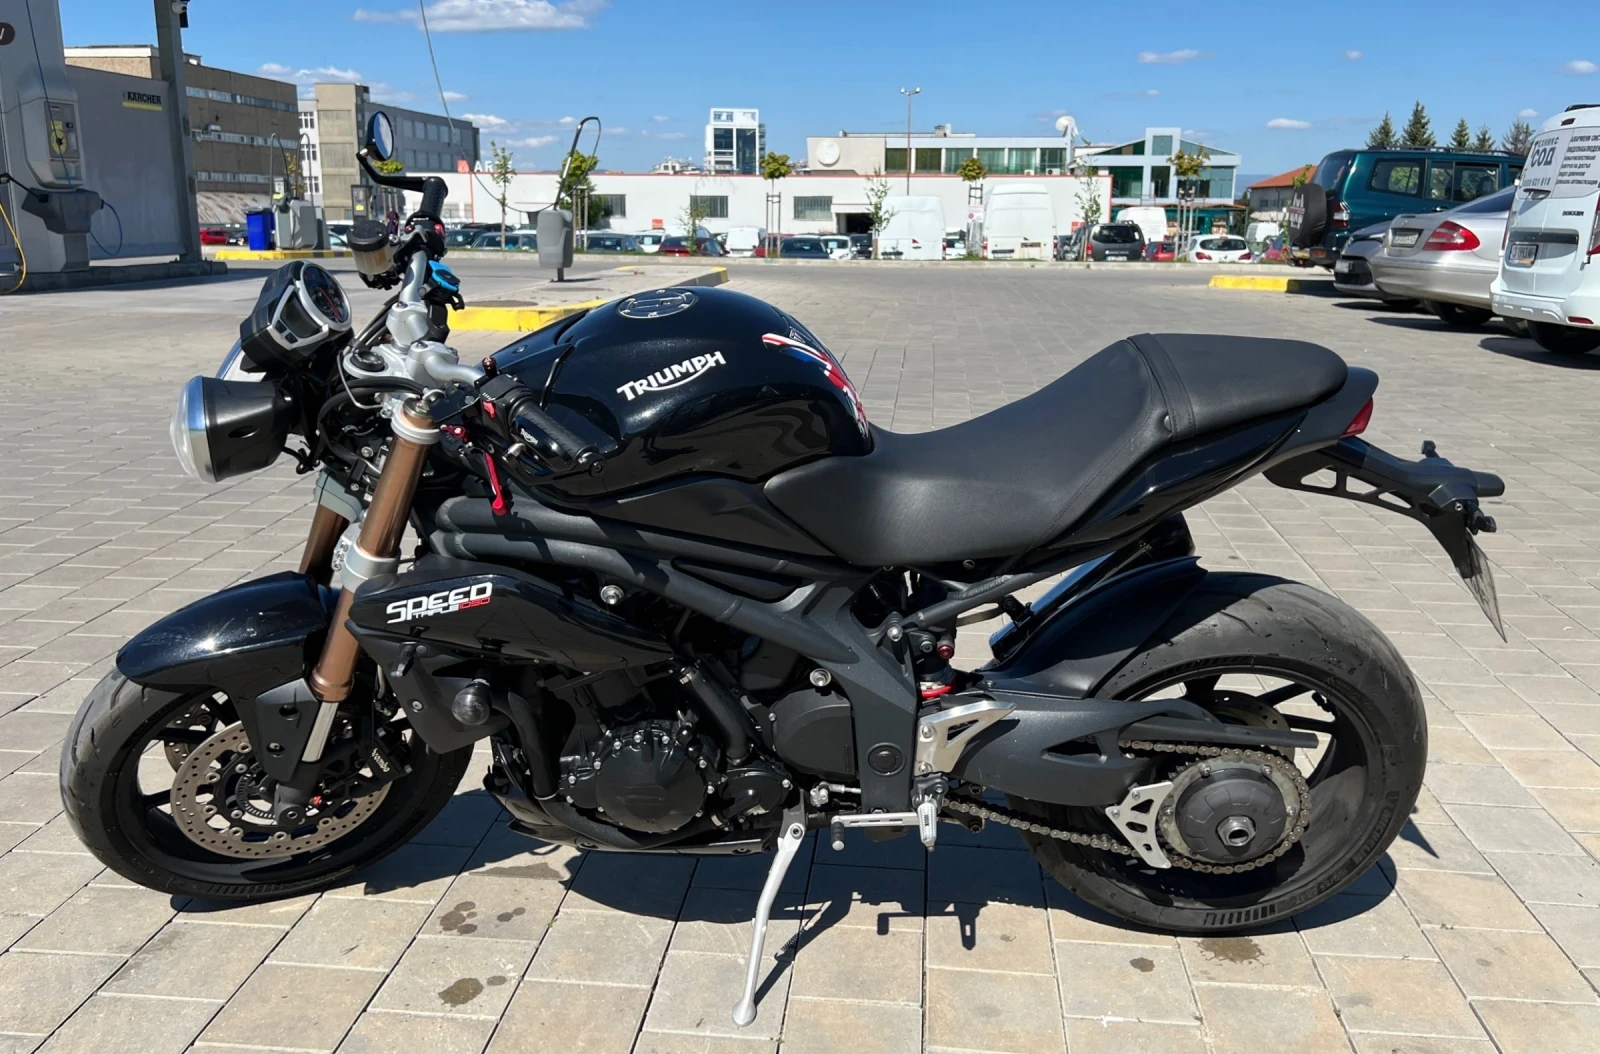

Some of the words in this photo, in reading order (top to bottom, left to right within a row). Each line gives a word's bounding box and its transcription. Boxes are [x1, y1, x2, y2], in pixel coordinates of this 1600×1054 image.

[616, 350, 726, 401] TRIUMPH
[386, 581, 493, 624] SPEED
[1352, 808, 1393, 865] MICHELIN
